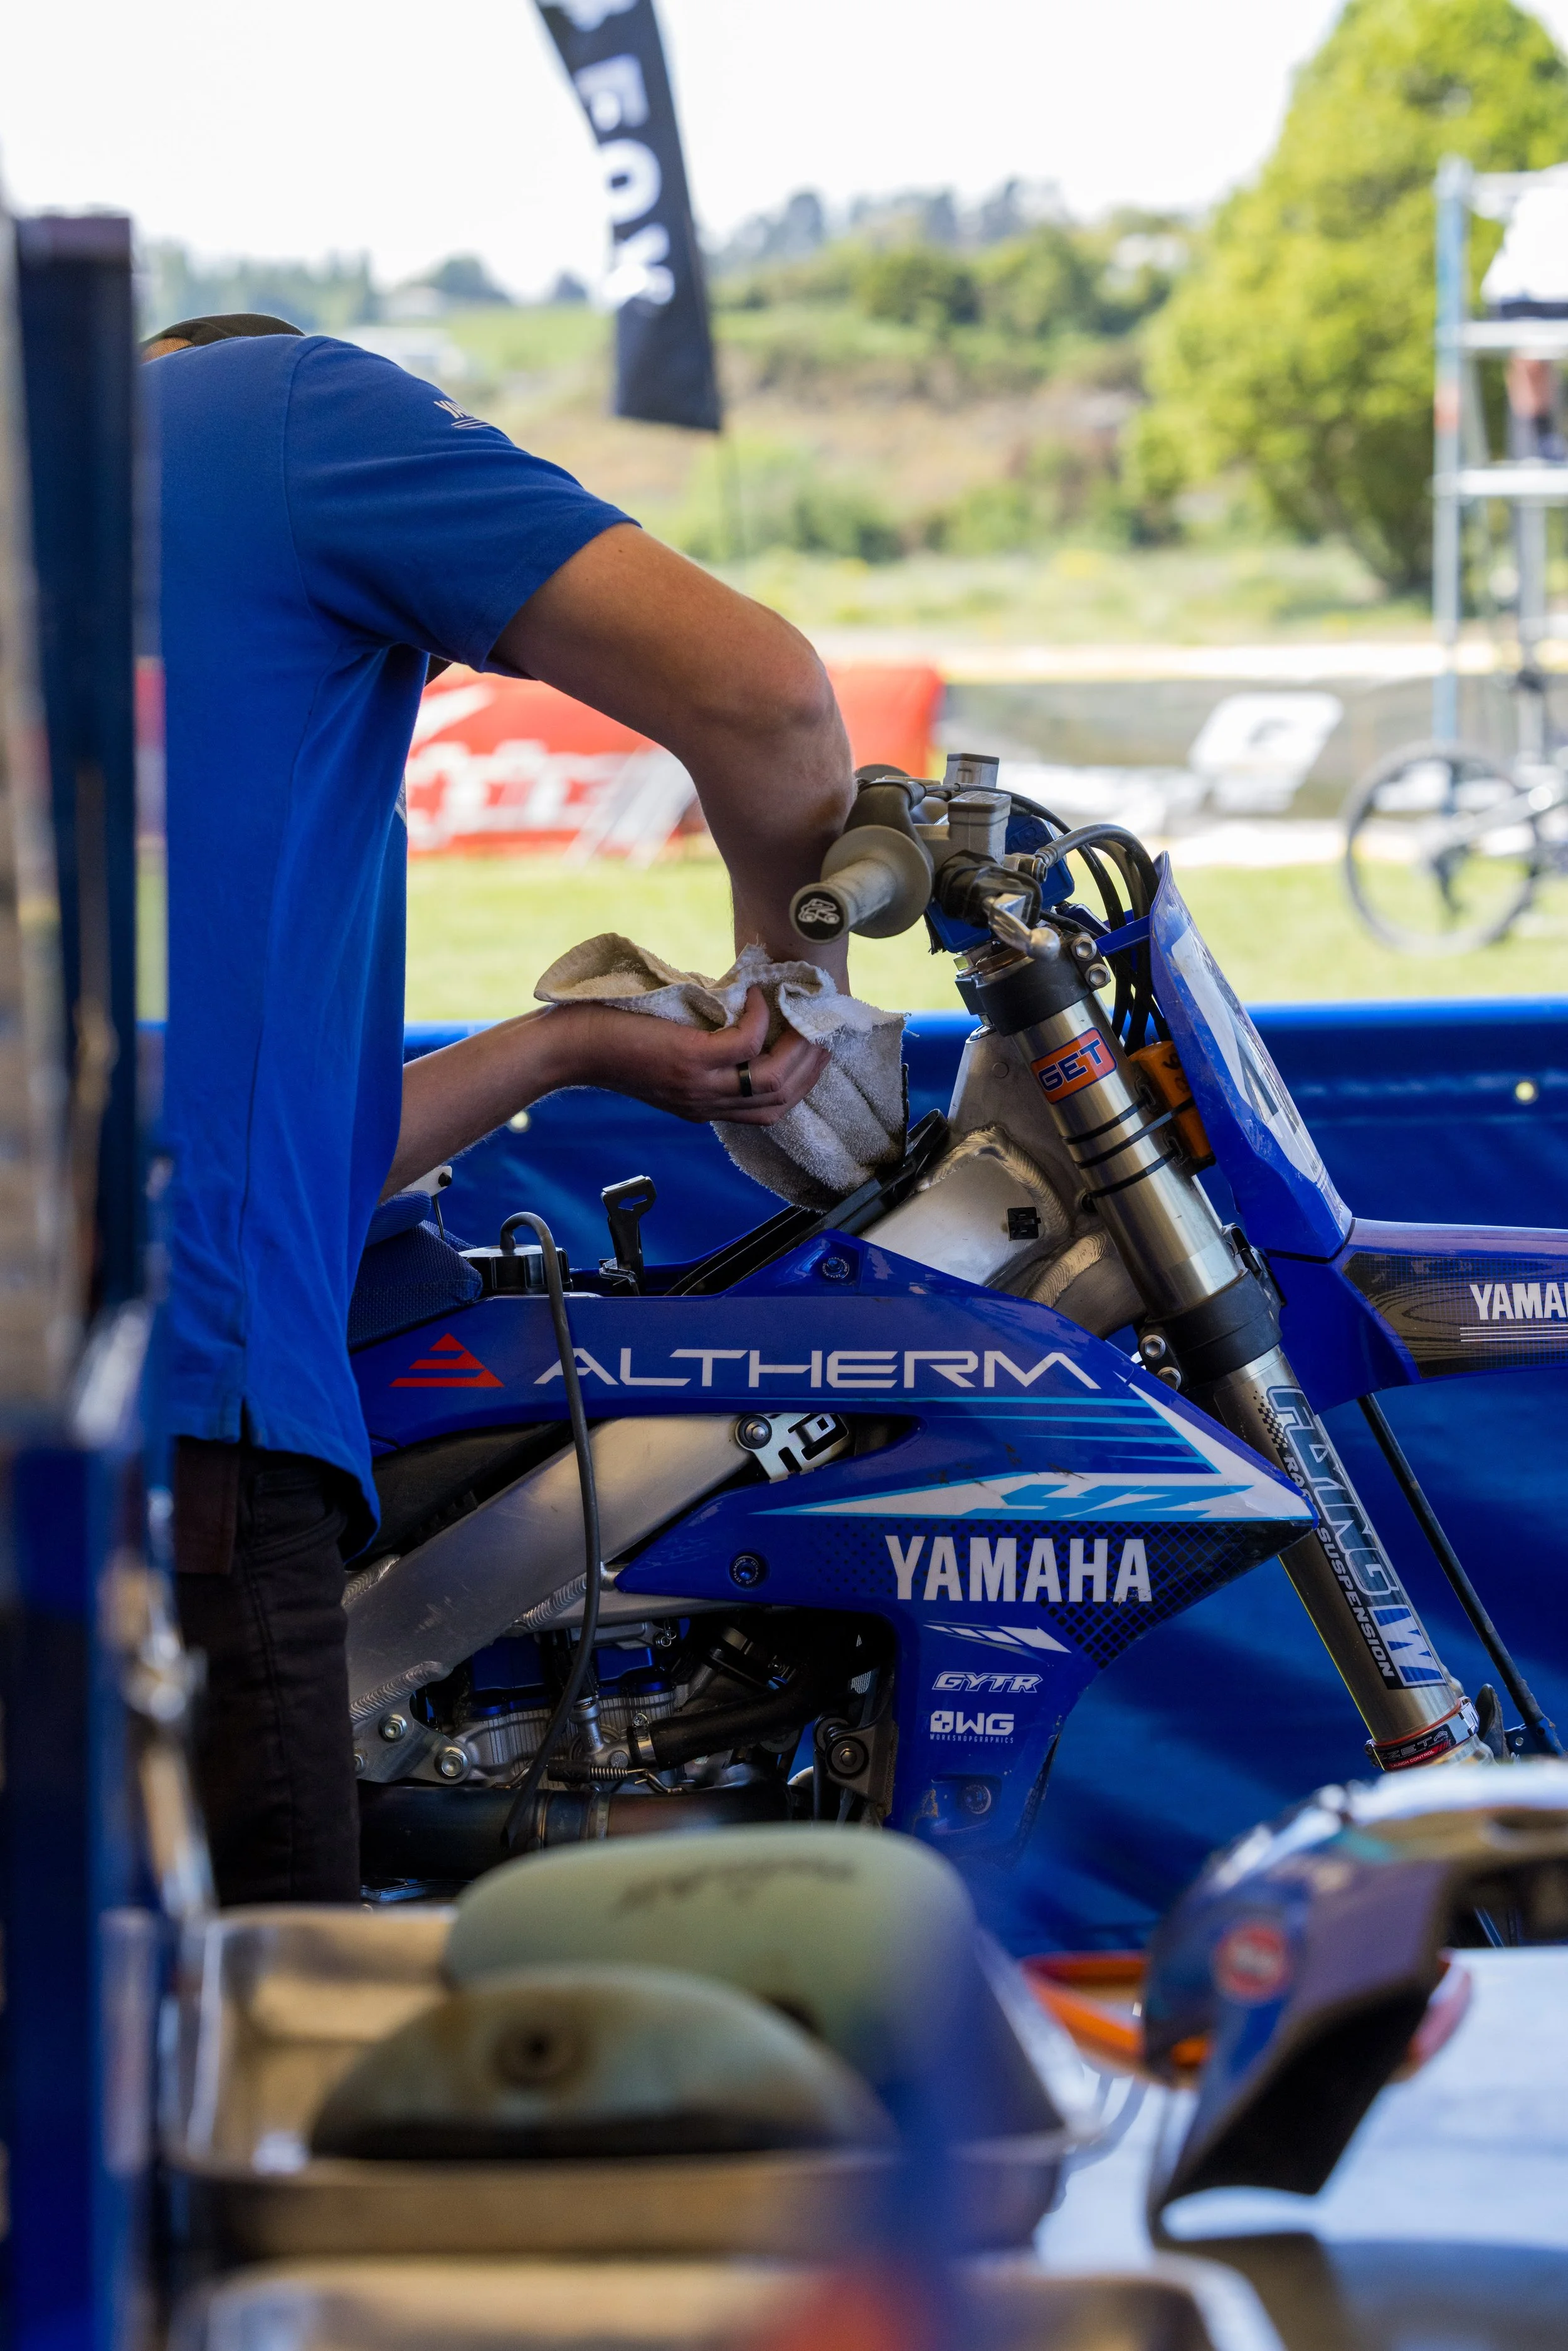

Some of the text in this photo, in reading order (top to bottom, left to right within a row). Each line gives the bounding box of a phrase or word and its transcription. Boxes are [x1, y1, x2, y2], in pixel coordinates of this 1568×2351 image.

[1037, 1038, 1103, 1092] GET
[1469, 1282, 1568, 1320] YAMA
[533, 1348, 1101, 1389] ALTHERM
[885, 1536, 1153, 1603] YAMAHA
[1283, 1457, 1396, 1677] RAC SUSPENSION
[931, 1671, 1044, 1693] GYTR
[930, 1733, 1014, 1744] WORKSHOPGRAPHICS
[1388, 1731, 1448, 1760] ZETA
[1391, 1749, 1436, 1768] LAUNCH CONTROL
